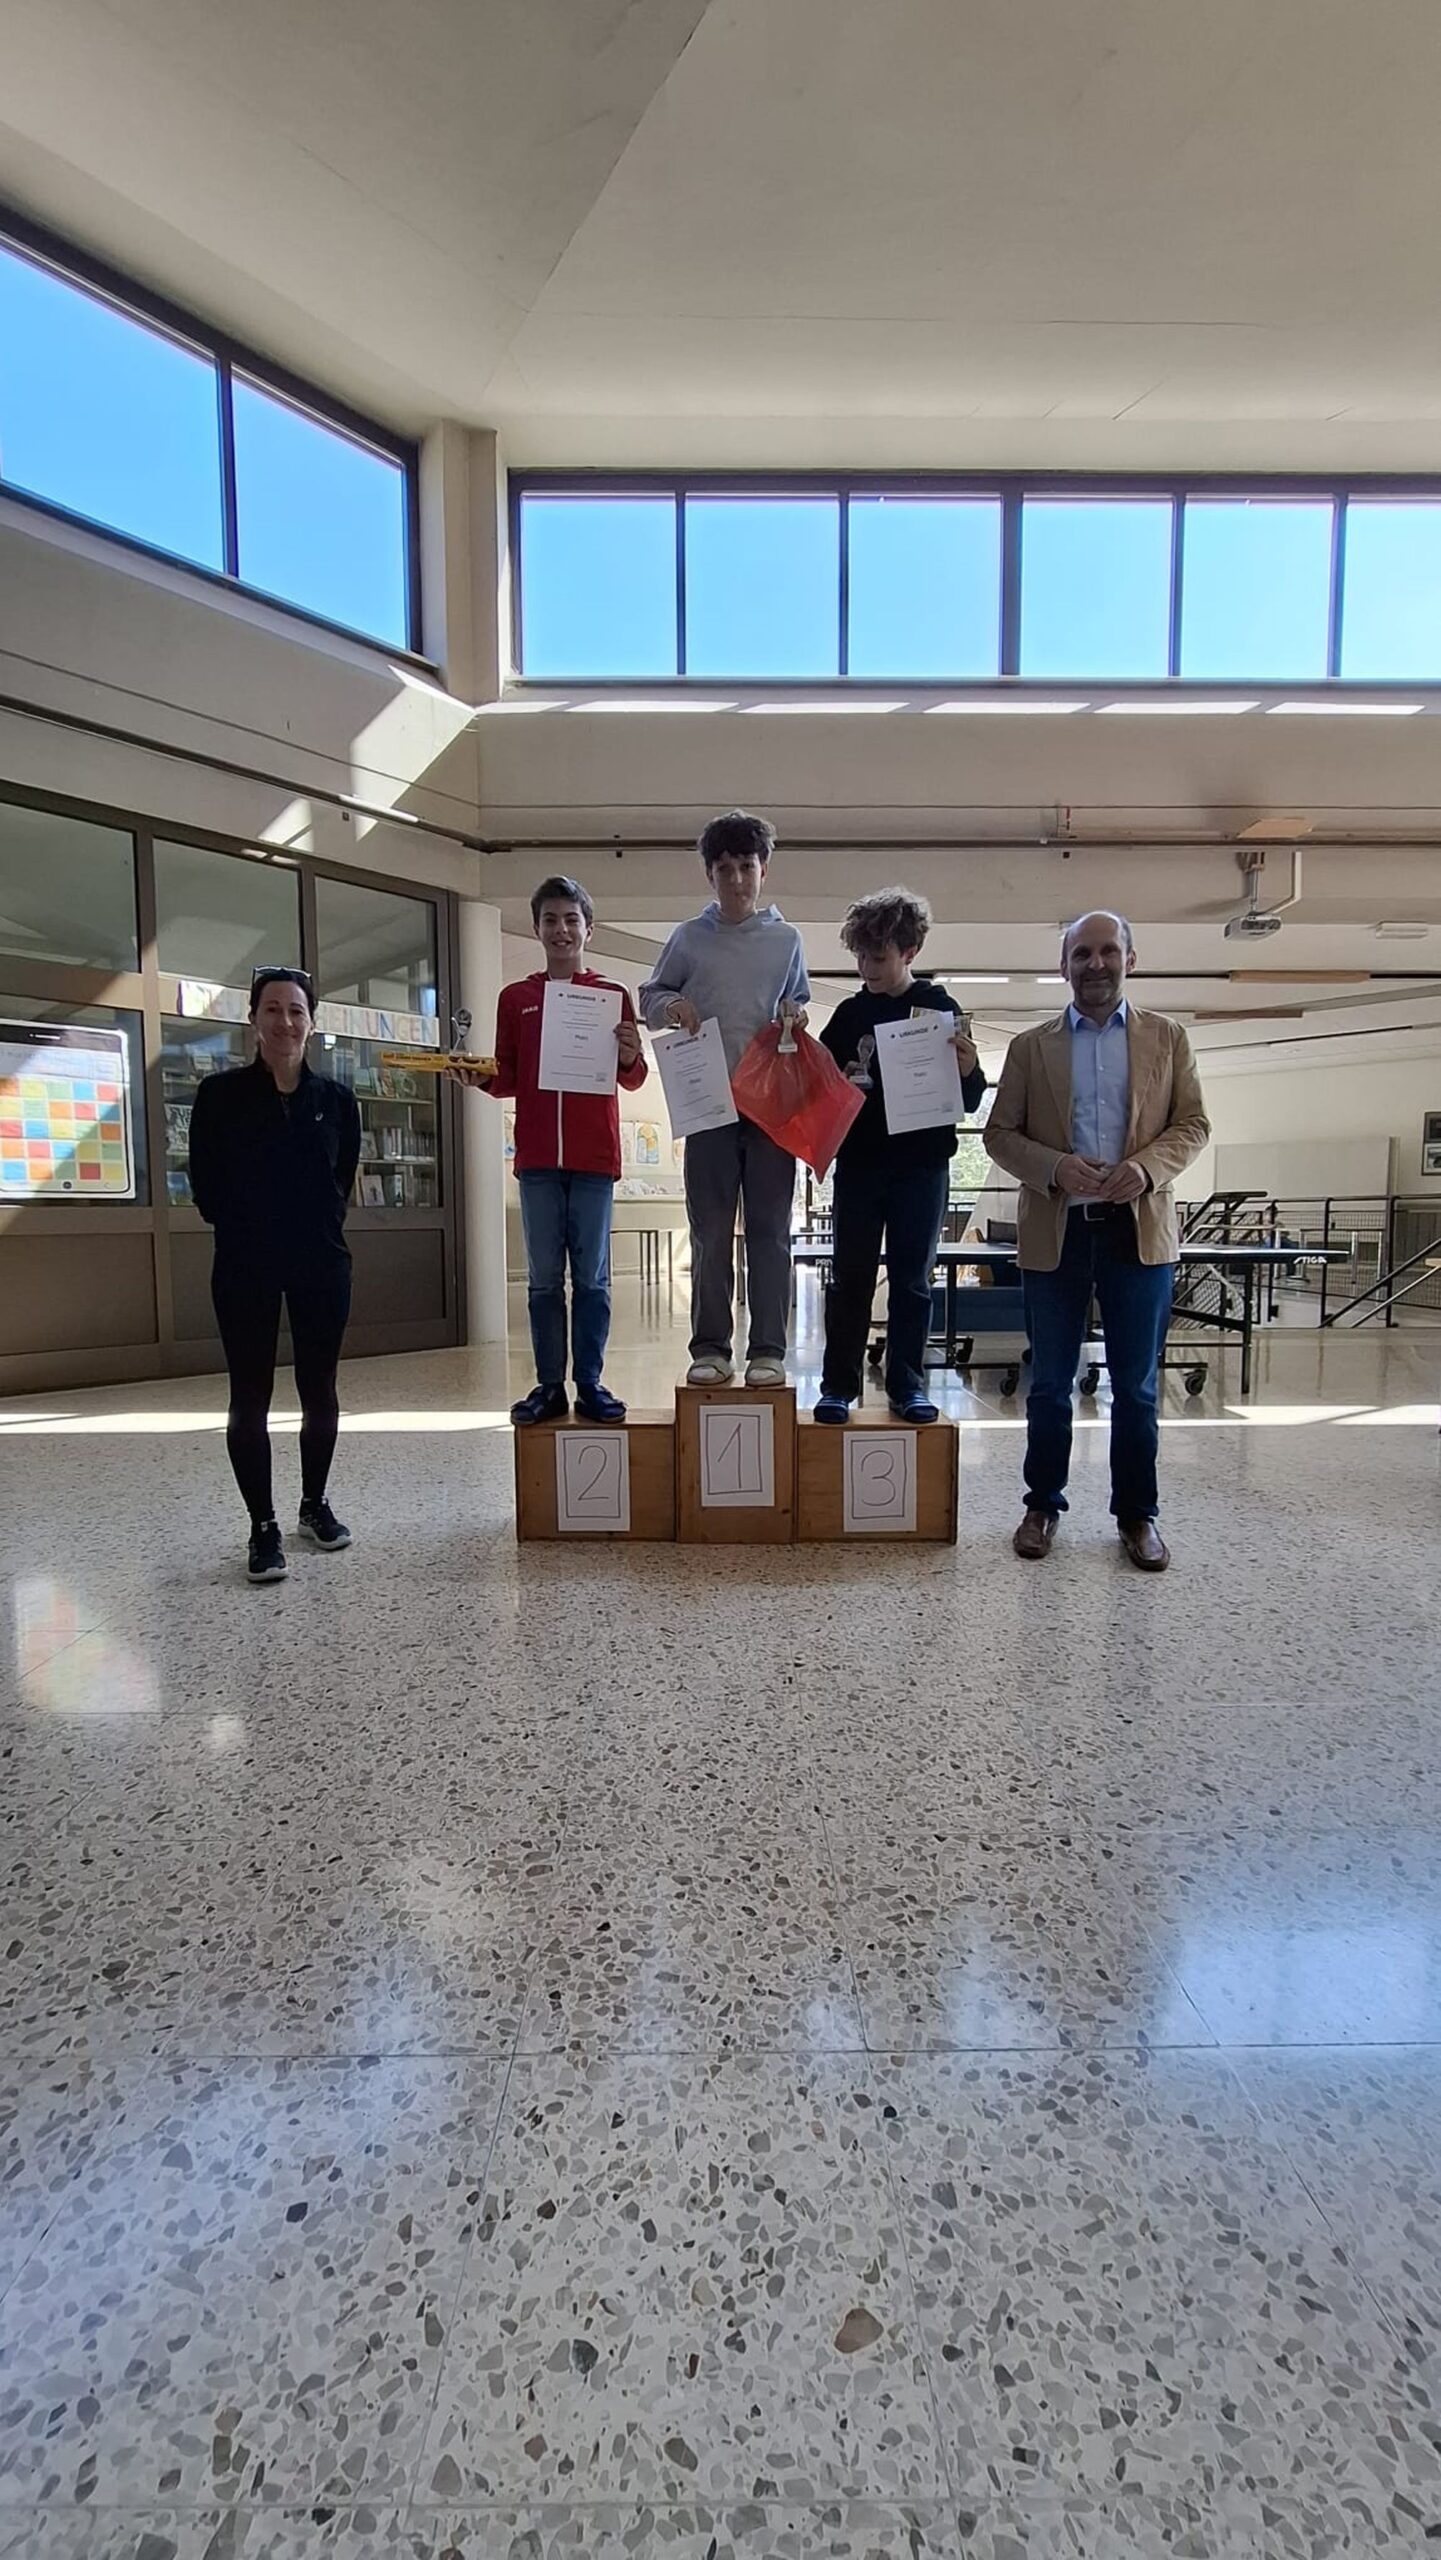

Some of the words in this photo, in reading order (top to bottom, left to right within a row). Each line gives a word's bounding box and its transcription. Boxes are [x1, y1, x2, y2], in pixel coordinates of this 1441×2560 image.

[899, 1027, 929, 1038] URKUNDE
[1293, 1256, 1327, 1264] STIGA
[577, 1445, 609, 1501] 2
[717, 1423, 742, 1489] 1
[861, 1449, 897, 1507] 3
